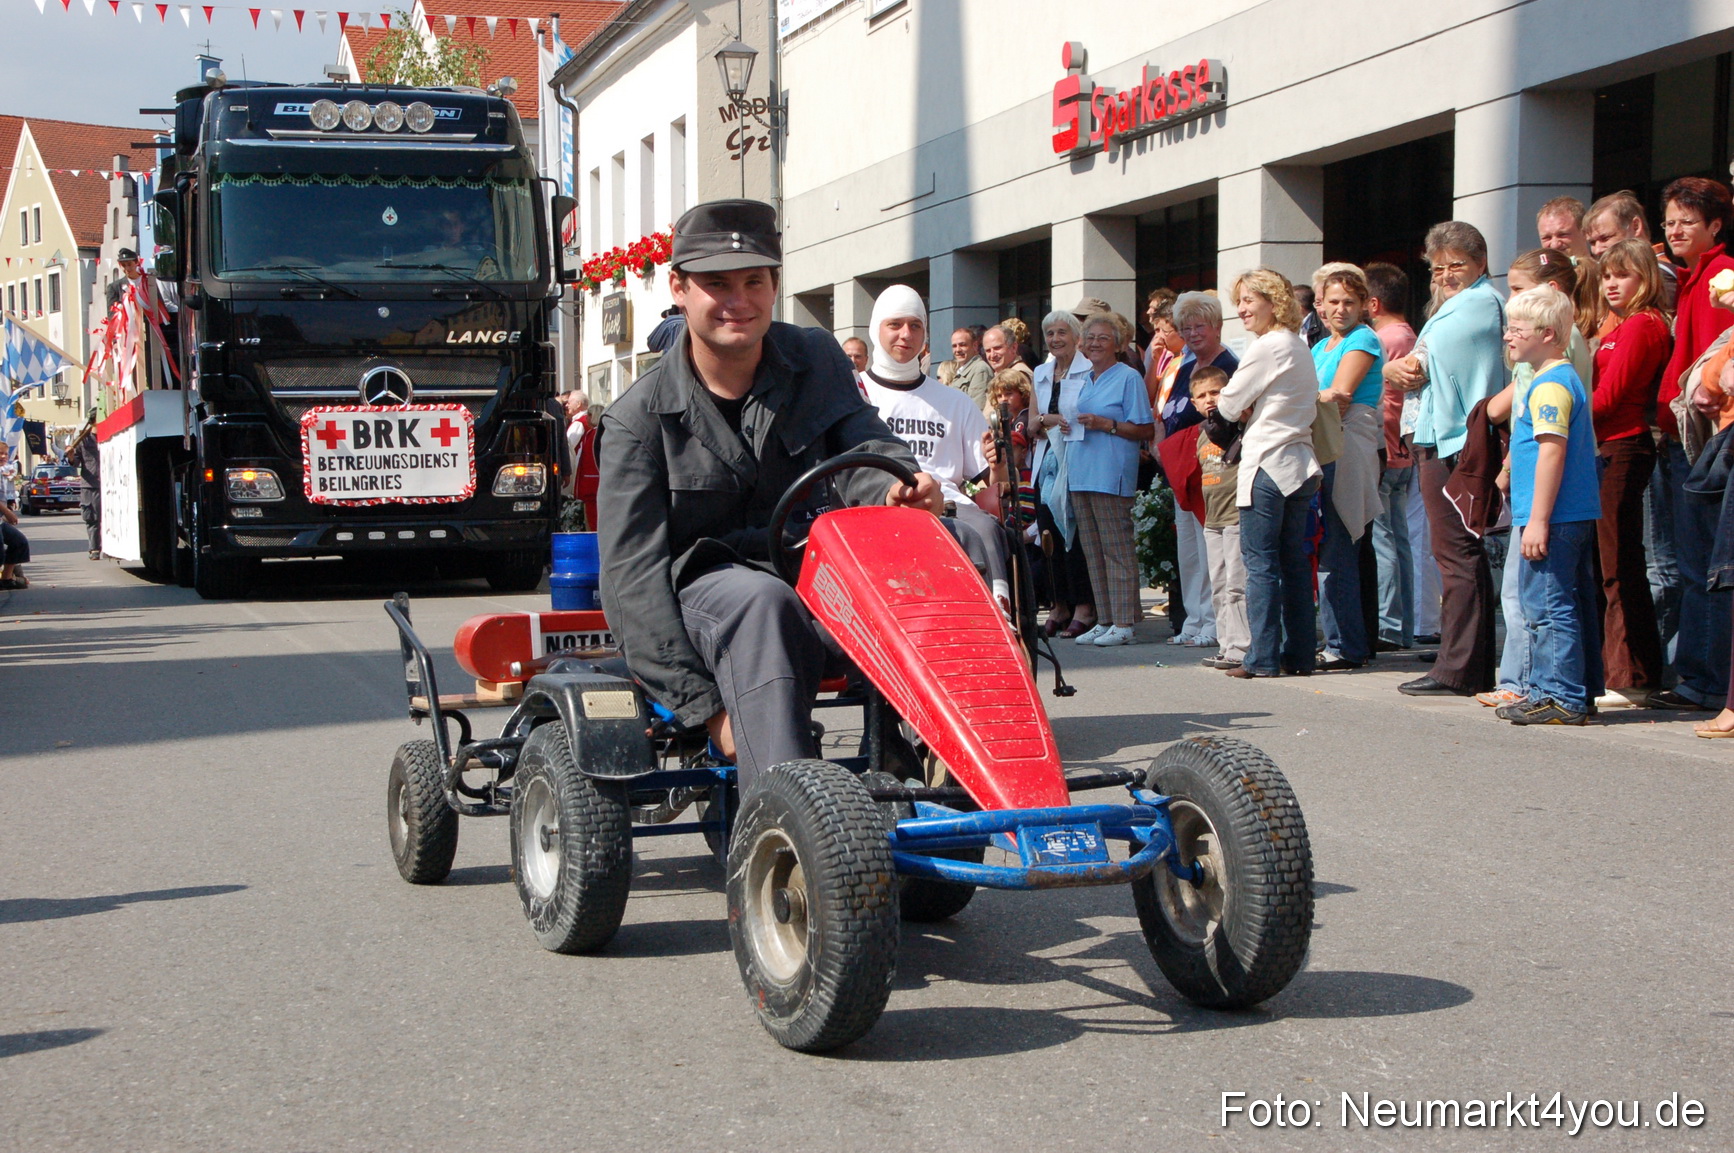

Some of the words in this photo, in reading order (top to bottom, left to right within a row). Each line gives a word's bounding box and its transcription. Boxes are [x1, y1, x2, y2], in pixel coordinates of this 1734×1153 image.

[1090, 58, 1210, 152] Sparkasse
[446, 331, 521, 344] LANGE
[352, 418, 421, 450] BRK
[886, 416, 945, 438] SCHUSS
[908, 439, 934, 457] OR!
[317, 453, 459, 472] BETREUUNGSDIENST
[318, 474, 402, 492] BEILNGRIES
